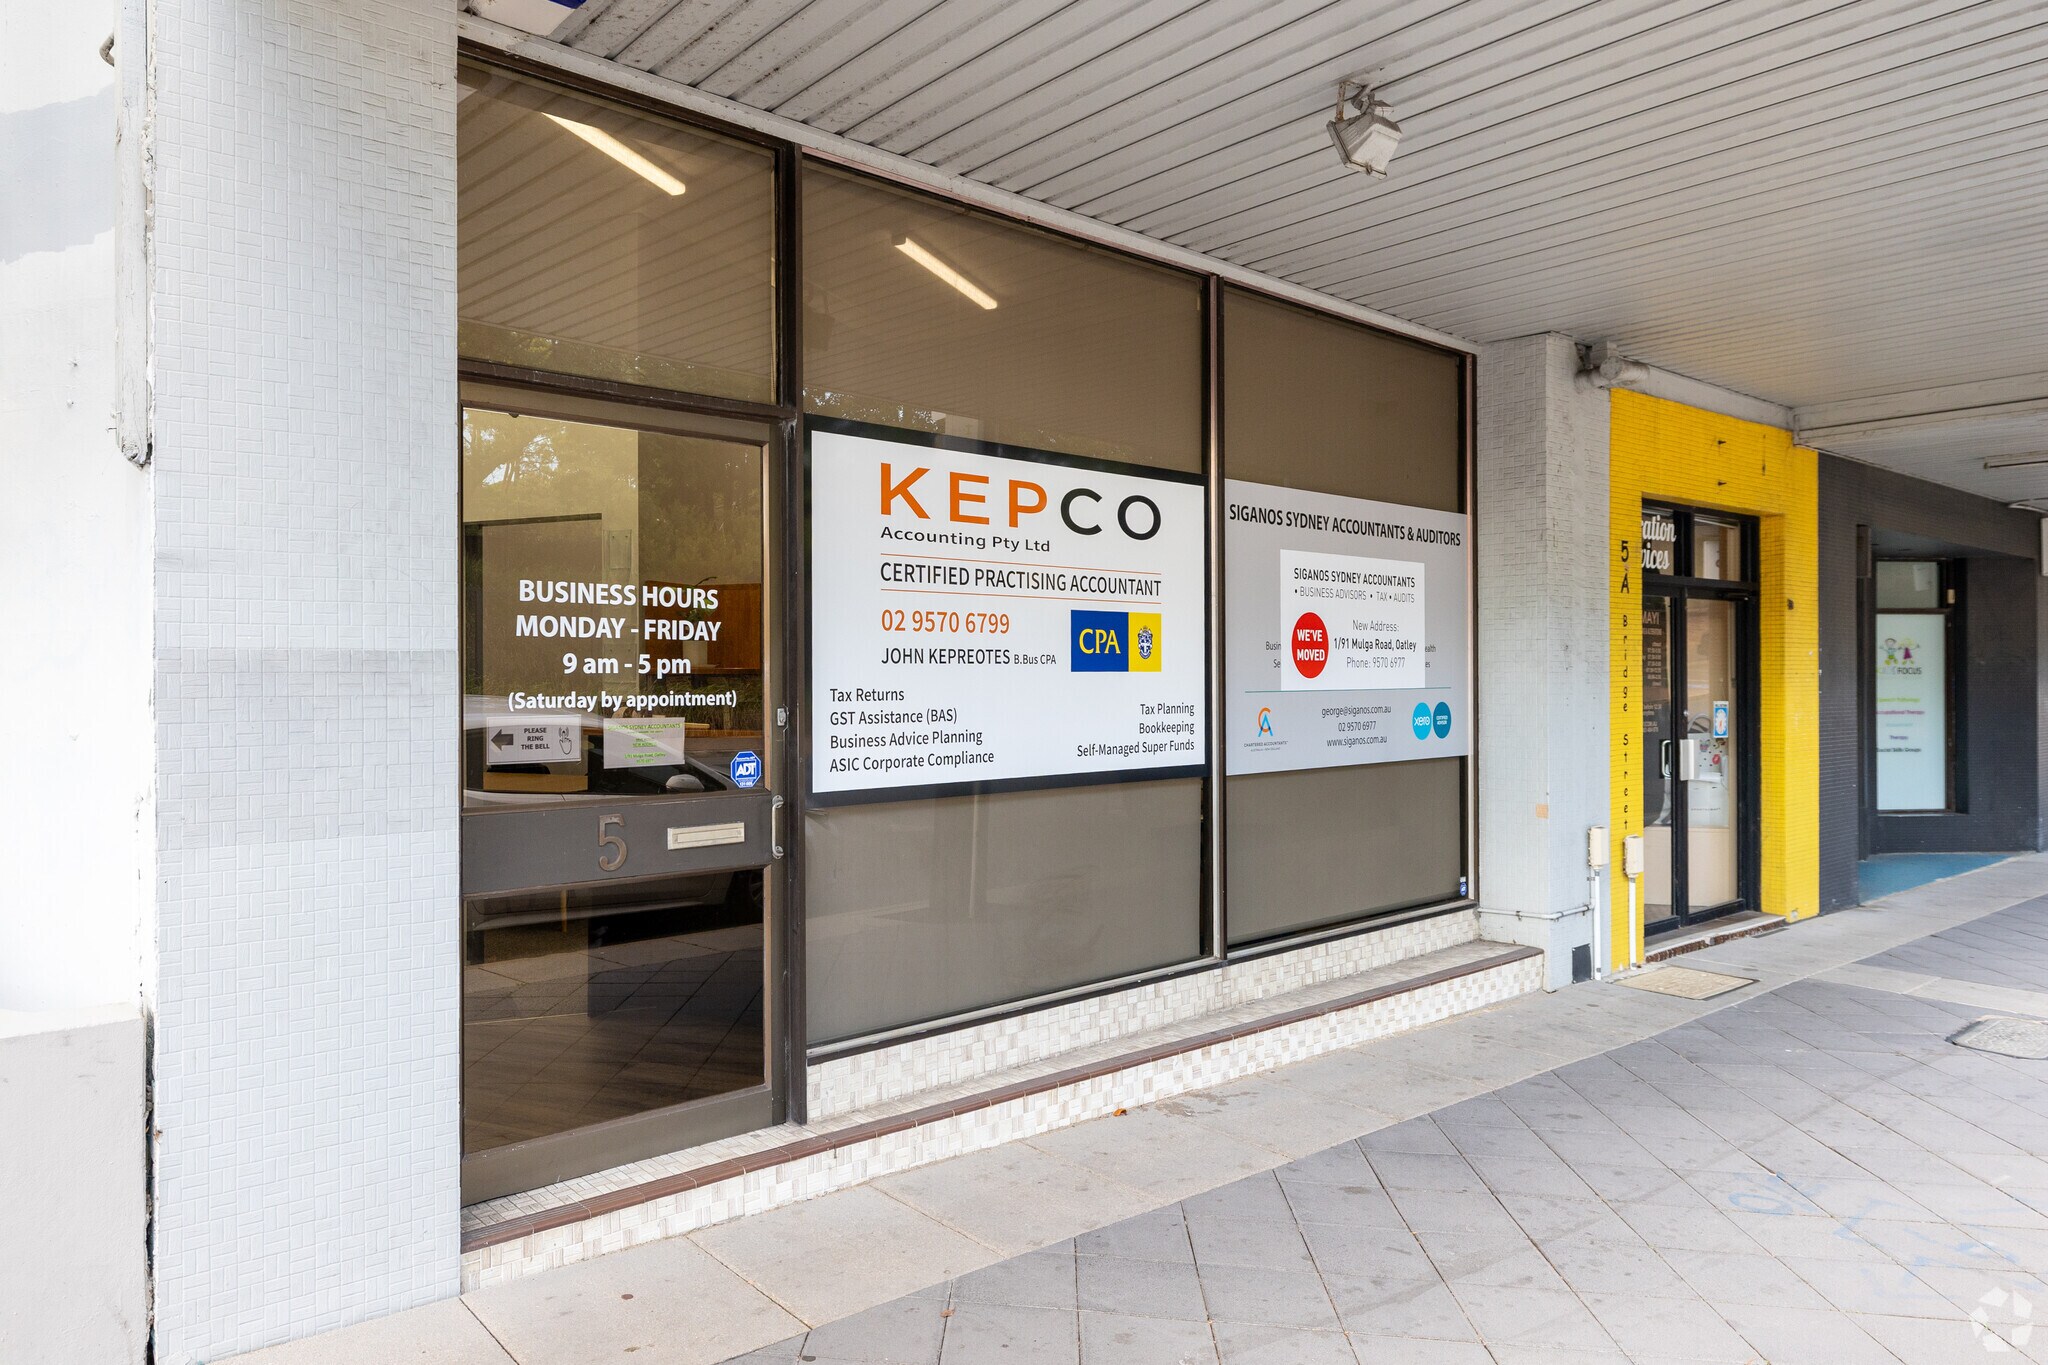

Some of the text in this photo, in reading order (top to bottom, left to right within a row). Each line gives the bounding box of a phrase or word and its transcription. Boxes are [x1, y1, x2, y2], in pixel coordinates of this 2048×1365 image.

[880, 462, 1162, 541] KEPCO
[1229, 504, 1461, 546] SIGANOS SYDNEY ACCOUNTANTS & AUDITORS
[1641, 515, 1677, 542] ation
[880, 526, 1050, 553] Accounting Pty Ltd
[880, 562, 1161, 597] CERTIFIED PRACTISING ACCOUNTANT
[1294, 567, 1415, 588] SIGANOS SYDNEY ACCOUNTANTS
[519, 579, 719, 610] BUSINESS HOURS
[1300, 586, 1415, 603] BUSINESS ADVISORS TAX AUDITS
[516, 615, 626, 639] MONDAY
[644, 619, 721, 641] FRIDAY
[881, 609, 1010, 634] 02 9570 6799
[1352, 620, 1399, 632] New Address:
[1079, 628, 1121, 655] CPA
[1297, 629, 1323, 642] WE'VE
[1334, 638, 1417, 653] 1/91 Mulga Road, Oatley
[881, 647, 1056, 665] JOHN KEPREOTES B.Bus CPA
[1297, 649, 1325, 662] MOVED
[1346, 657, 1405, 668] Phone: 9570 6977
[563, 653, 577, 674] 9
[583, 657, 619, 674] am
[638, 654, 650, 675] 5
[657, 656, 691, 679] pm
[508, 690, 737, 712] (Saturday by appointment)
[830, 687, 905, 702] Tax Returns
[830, 707, 958, 726] GST Assistance (BAS)
[1140, 702, 1195, 717] Tax Planning
[1321, 704, 1391, 718] george@siganos.com.au
[1139, 721, 1195, 736] Bookkeeping
[1338, 721, 1376, 731] 02 9570 6977
[1414, 716, 1430, 726] xero
[830, 729, 983, 749] Business Advice Planning
[1077, 739, 1195, 758] Self-Managed Super Funds
[1327, 735, 1387, 747] www.siganos.com.au
[736, 762, 756, 776] ADT
[830, 751, 995, 774] ASIC Corporate Compliance
[599, 813, 628, 872] 5
